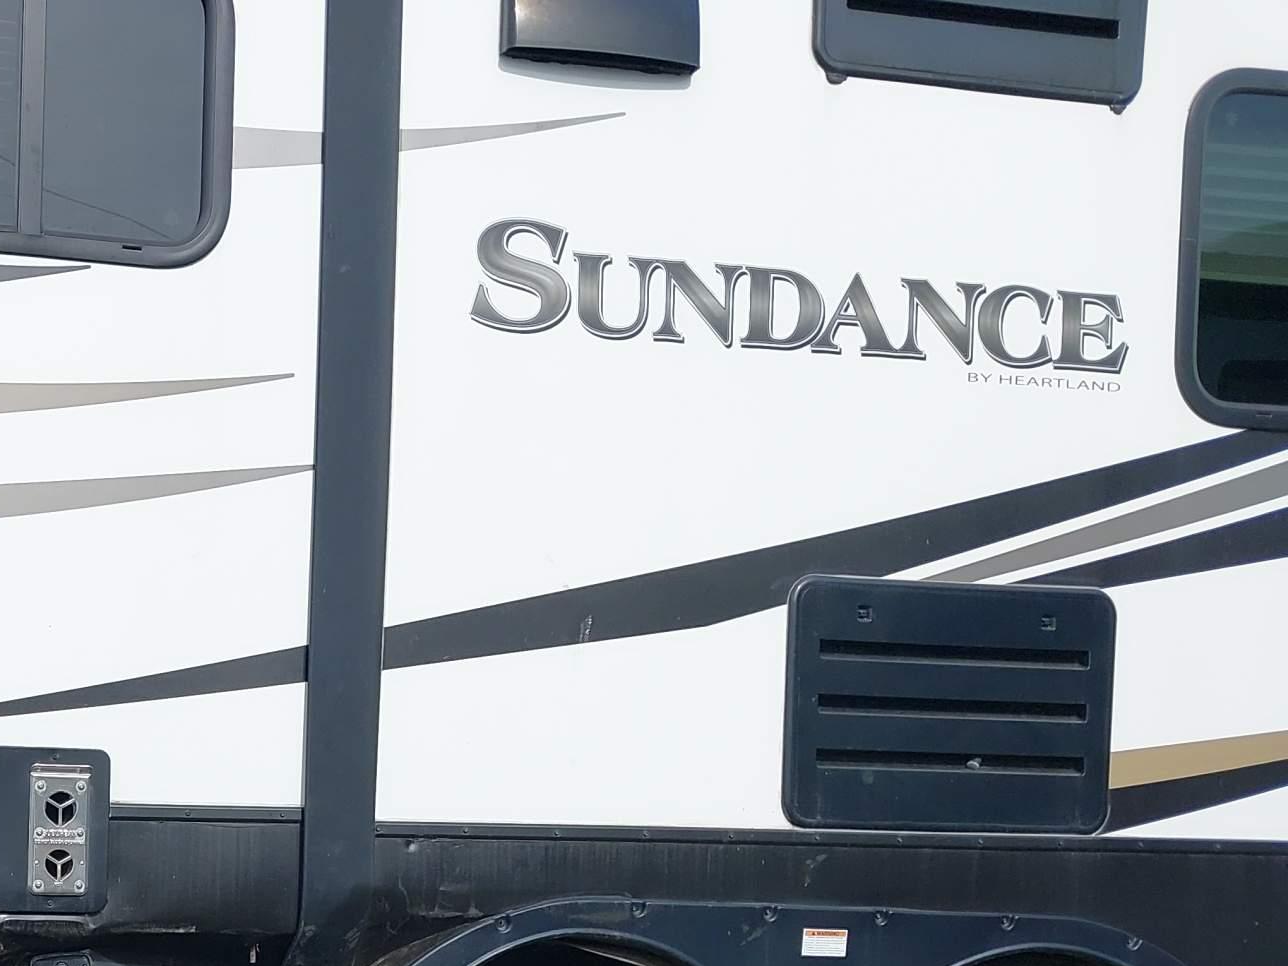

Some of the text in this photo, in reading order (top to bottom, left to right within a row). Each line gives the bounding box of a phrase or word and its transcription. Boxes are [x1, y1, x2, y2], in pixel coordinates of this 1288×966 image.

[469, 216, 1130, 374] SUNDANCE
[967, 372, 1122, 393] BY HEARTLAND
